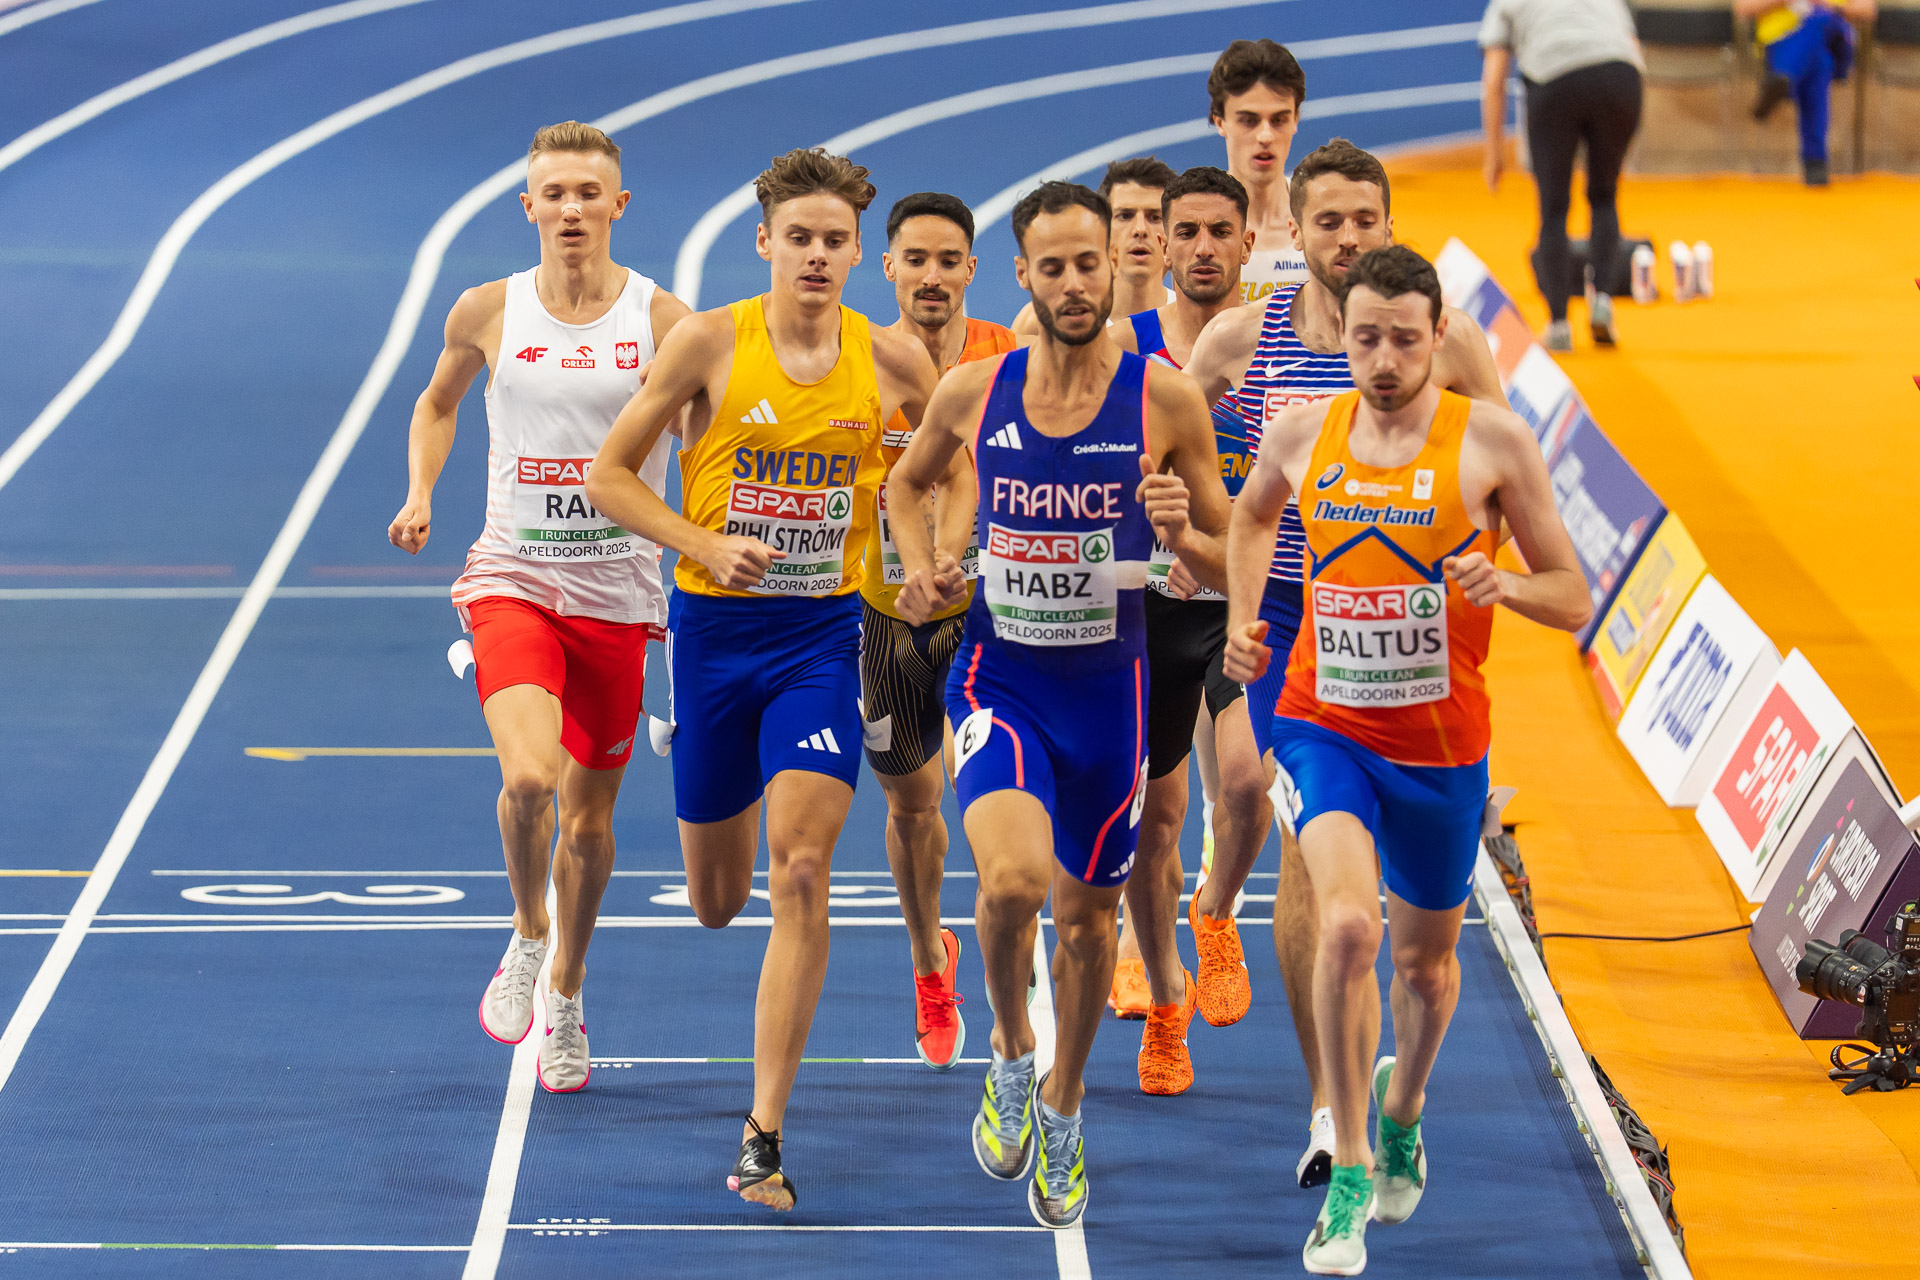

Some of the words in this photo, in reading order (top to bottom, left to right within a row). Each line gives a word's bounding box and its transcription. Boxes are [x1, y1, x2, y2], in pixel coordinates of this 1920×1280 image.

[1274, 260, 1307, 270] Allian
[516, 346, 548, 363] 4F
[562, 360, 594, 368] ORLEN
[829, 419, 868, 430] BAUHAUS
[1109, 443, 1137, 452] Mutuel
[732, 447, 862, 486] SWEDEN
[546, 494, 605, 519] RA
[734, 489, 824, 517] SPAR
[992, 476, 1123, 519] FRANCE
[545, 531, 570, 540] RUN
[573, 530, 608, 540] CLEAN
[519, 544, 603, 557] APELDOORN
[606, 542, 631, 555] 2025
[991, 533, 1077, 560] SPAR
[782, 565, 818, 574] CLEAN
[758, 577, 809, 591] DOORN
[810, 578, 839, 590] 2025
[1006, 568, 1092, 599] HABZ
[1316, 591, 1404, 616] SPAR
[1017, 608, 1040, 620] RUN
[1043, 611, 1085, 621] CLEAN
[999, 622, 1076, 640] PELDOORN
[1080, 624, 1112, 638] 2025
[1319, 626, 1442, 658] BALTUS
[1345, 670, 1369, 681] RUN
[1371, 669, 1414, 681] CLEAN
[1321, 684, 1406, 700] APELDOORN
[1409, 683, 1444, 697] 2025
[606, 735, 634, 756] 4F
[1736, 715, 1808, 830] SPAR
[1829, 818, 1881, 903] EUROVISION
[180, 884, 466, 905] 3
[1798, 871, 1838, 935] SPORT
